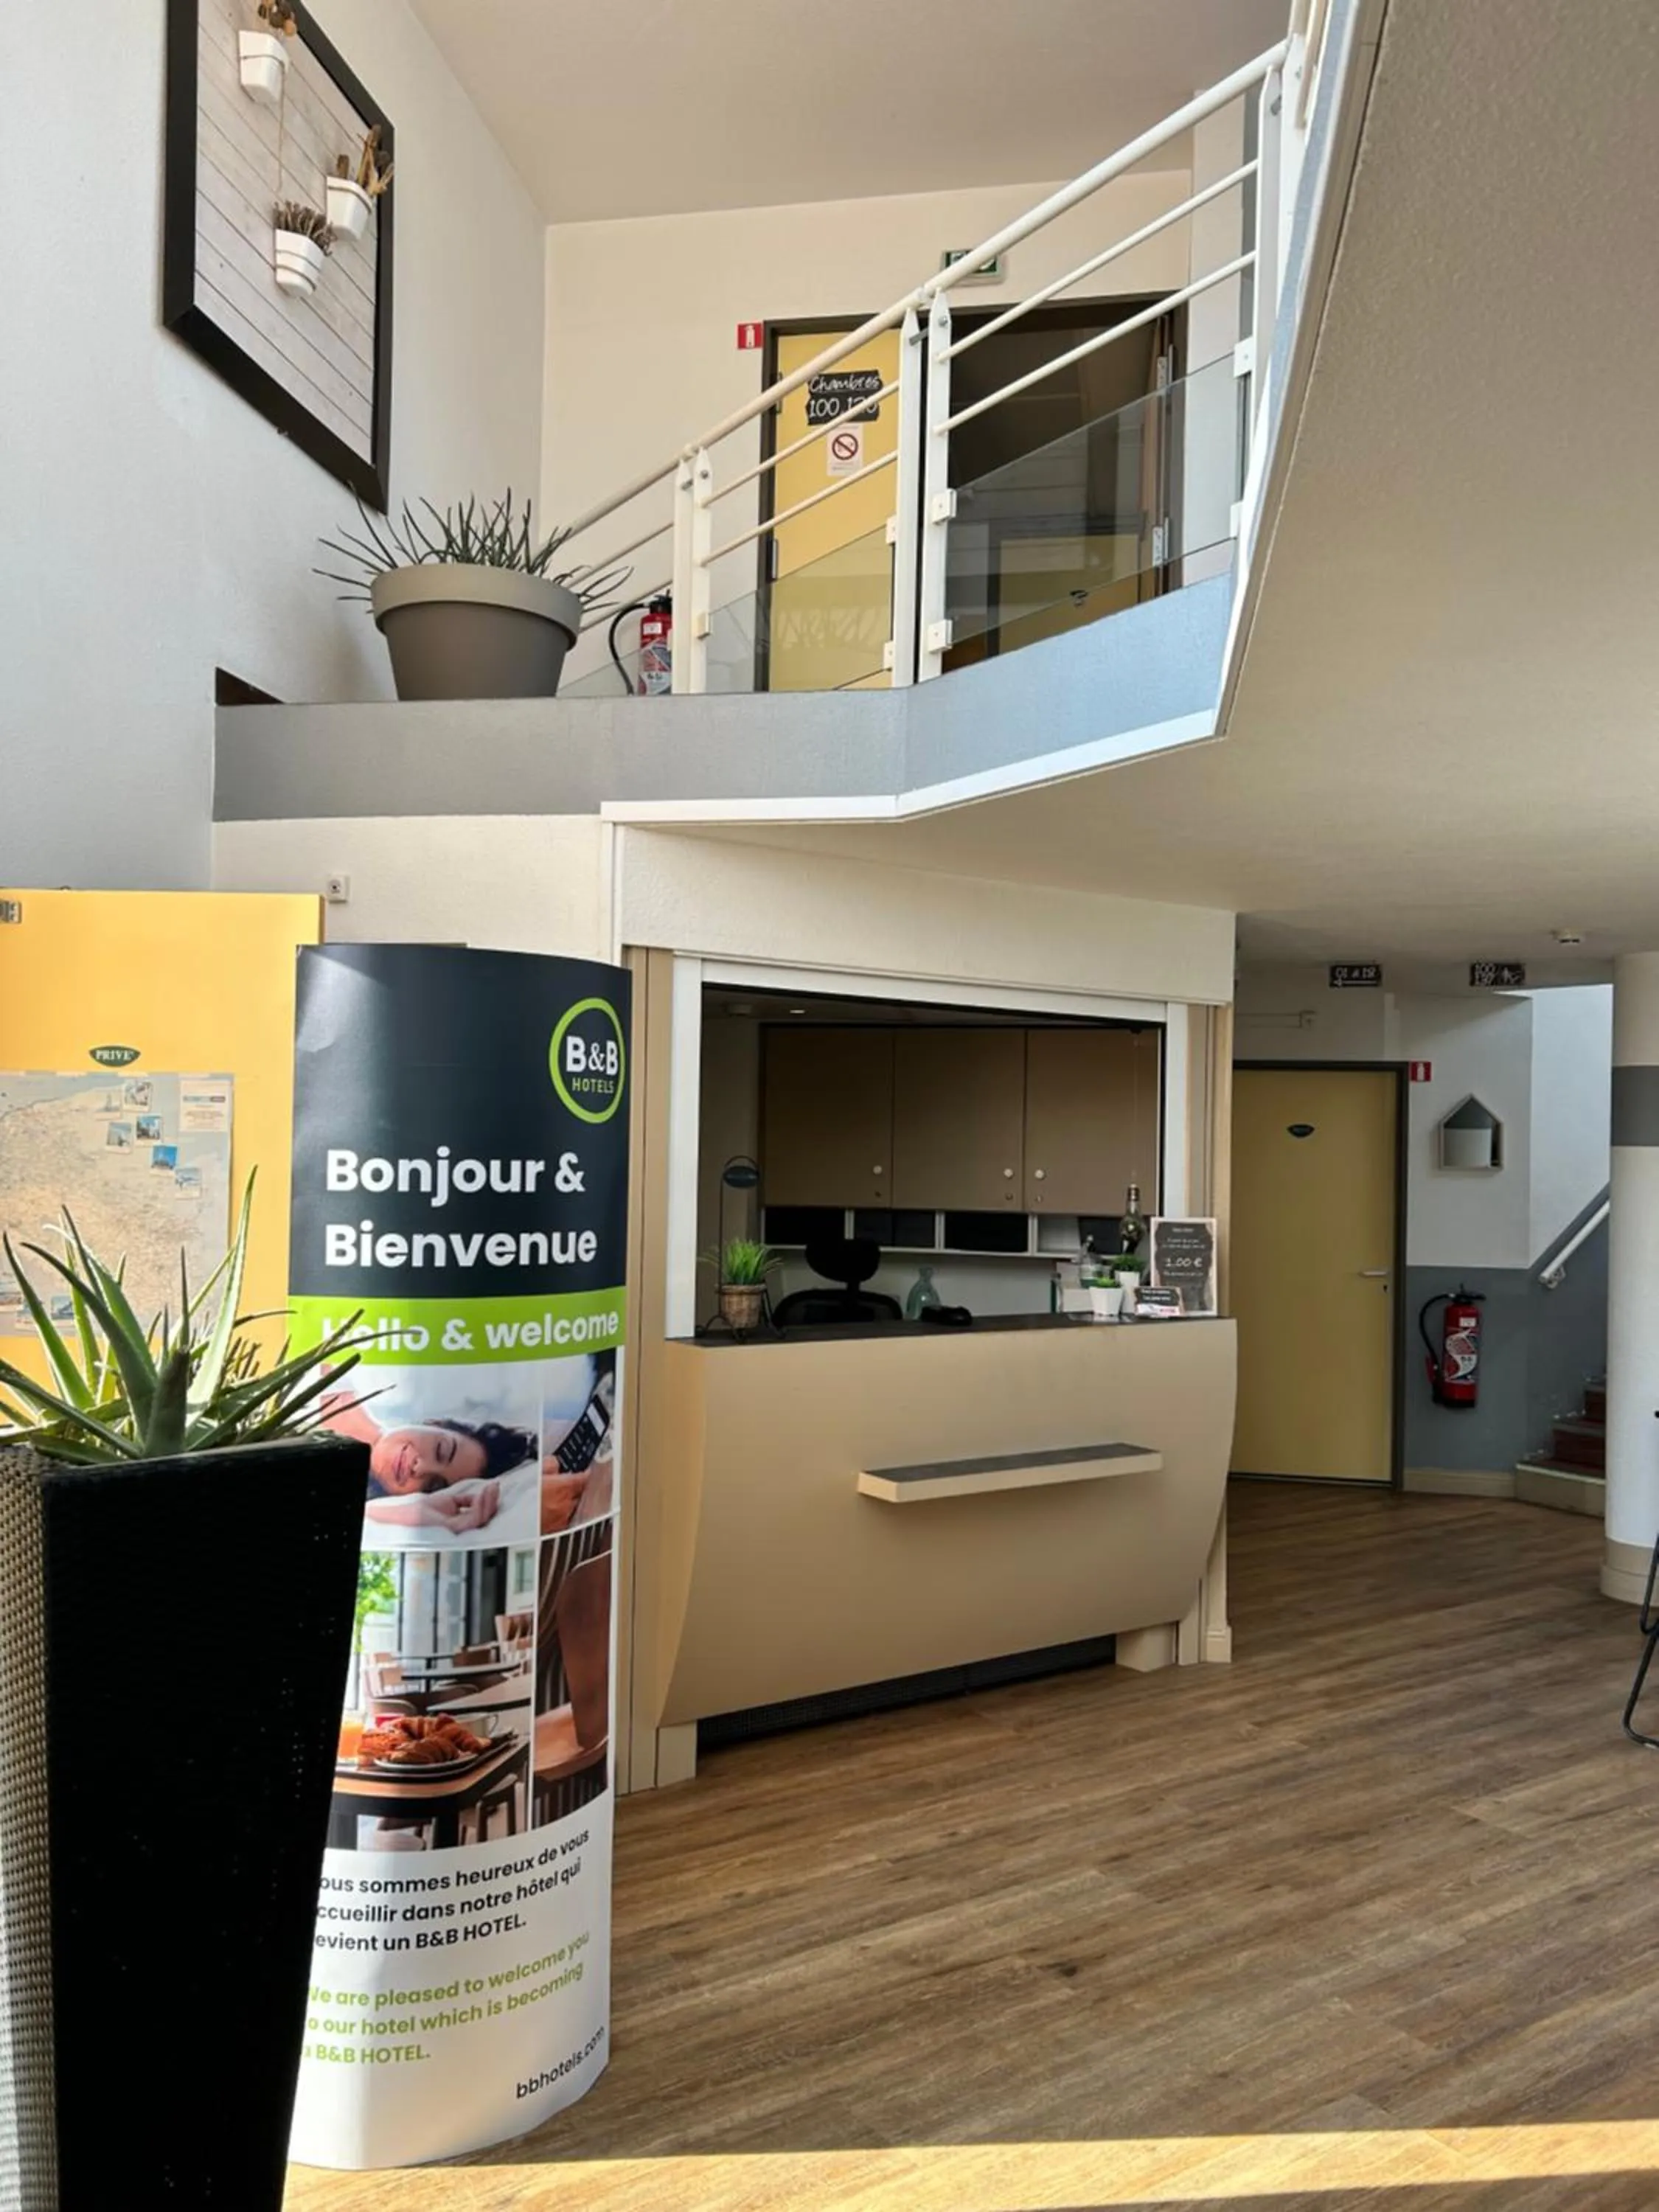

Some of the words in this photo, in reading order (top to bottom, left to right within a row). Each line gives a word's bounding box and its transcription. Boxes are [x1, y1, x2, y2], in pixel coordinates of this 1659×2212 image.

[810, 375, 879, 392] Chambres
[810, 397, 840, 418] 100
[566, 1035, 619, 1075] B&B
[572, 1077, 614, 1093] HOTELS
[326, 1146, 545, 1207] Bonjour
[554, 1152, 585, 1193] &
[324, 1220, 597, 1267] Bienvenue
[442, 1319, 475, 1351] &
[485, 1310, 619, 1349] welcome
[319, 1877, 354, 1892] ous
[359, 1876, 451, 1893] sommes
[456, 1857, 535, 1887] heureux
[538, 1848, 557, 1865] de
[560, 1830, 589, 1856] vous
[317, 1905, 398, 1922] ccueillir
[402, 1903, 455, 1921] dans
[460, 1891, 512, 1914] notre
[516, 1871, 558, 1900] hôtel
[560, 1857, 581, 1884] qui
[315, 1932, 378, 1951] evient
[383, 1936, 410, 1951] un
[416, 1928, 459, 1949] B&B
[463, 1914, 526, 1941] HOTEL.
[336, 1992, 369, 2006] are
[375, 1981, 459, 2011] pleased
[464, 1978, 484, 1994] to
[487, 1947, 566, 1988] welcome
[566, 1931, 590, 1959] you
[323, 2019, 356, 2034] our
[361, 2016, 415, 2035] hotel
[420, 2004, 483, 2031] which
[487, 1999, 503, 2017] is
[507, 1961, 584, 2010] becoming
[316, 2043, 355, 2063] B&B
[361, 2045, 431, 2064] HOTEL.
[516, 2025, 605, 2099] bbhotels.com
